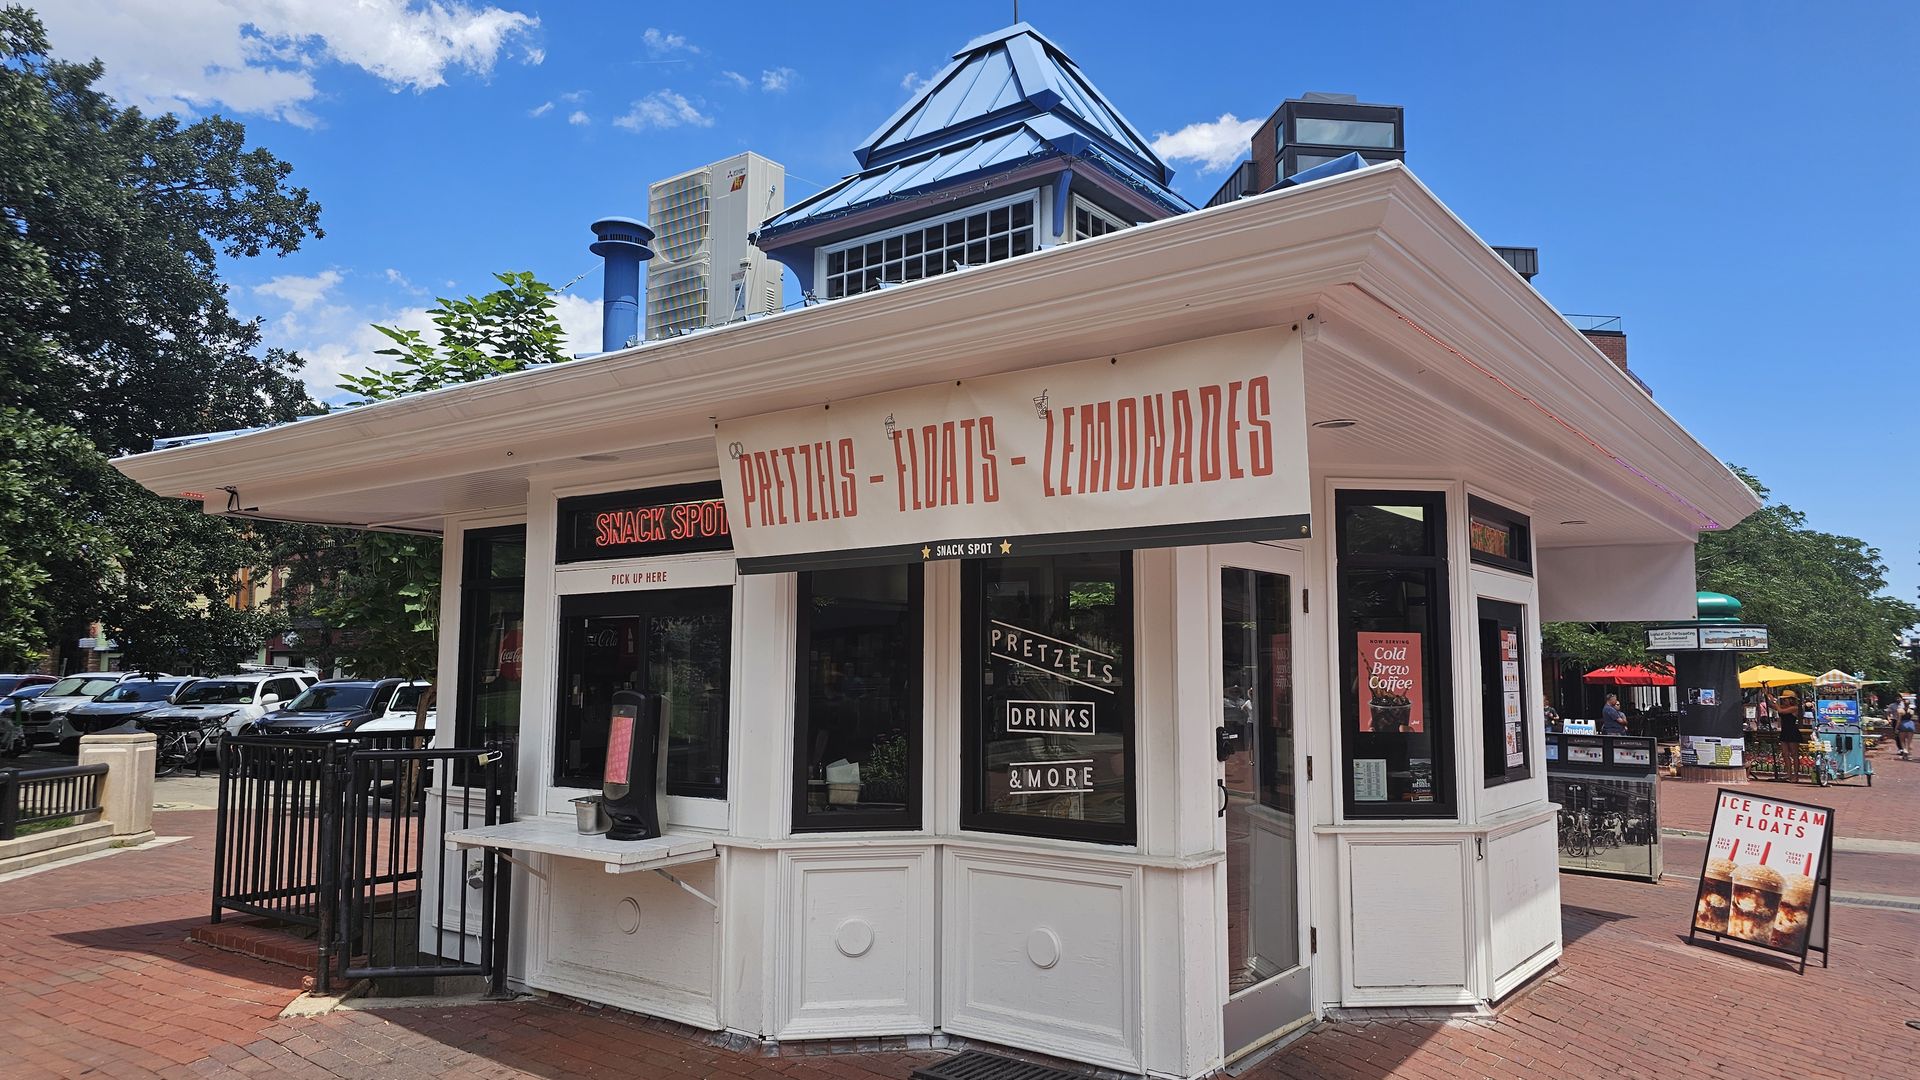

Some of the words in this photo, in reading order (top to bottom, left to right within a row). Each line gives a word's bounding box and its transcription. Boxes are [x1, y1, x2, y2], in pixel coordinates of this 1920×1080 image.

[739, 438, 859, 528] PRETZELS
[893, 415, 1000, 513] FLOATS
[1042, 375, 1274, 498] LEMONADES
[596, 507, 667, 547] SNACK
[671, 501, 729, 540] SPOT
[936, 543, 965, 557] SNACK
[968, 543, 993, 555] SPOT
[611, 573, 630, 585] PICK
[633, 572, 643, 584] UP
[646, 571, 668, 583] HERE
[991, 629, 1114, 684] PRETZELS
[1374, 646, 1407, 660] Cold
[1371, 661, 1410, 675] Brew
[1369, 675, 1413, 692] Coffee
[1011, 707, 1090, 729] DRINKS
[1820, 707, 1856, 715] Slushies
[1721, 796, 1752, 812] ICE
[1761, 803, 1825, 826] CREAM
[1735, 814, 1806, 839] FLOATS
